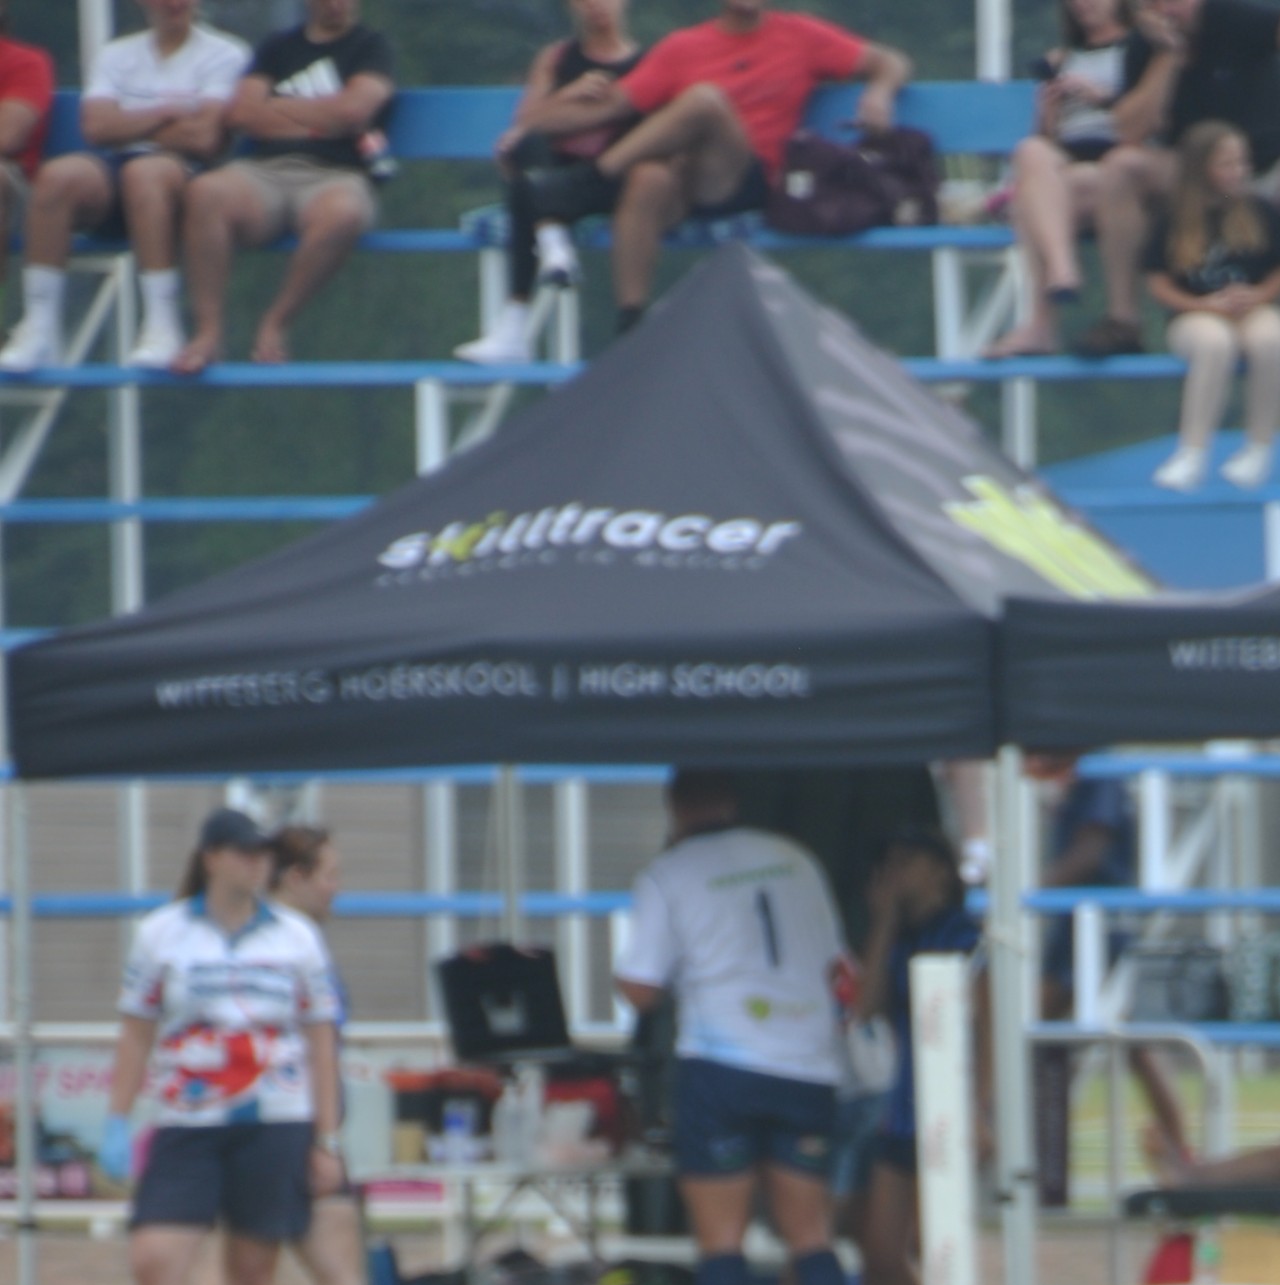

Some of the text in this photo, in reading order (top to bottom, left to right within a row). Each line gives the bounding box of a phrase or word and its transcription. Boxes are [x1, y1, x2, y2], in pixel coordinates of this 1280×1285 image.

[378, 501, 801, 569] skilltracer
[578, 662, 669, 698] HIGH
[671, 662, 810, 698] SCHOOL
[754, 887, 782, 974] 1
